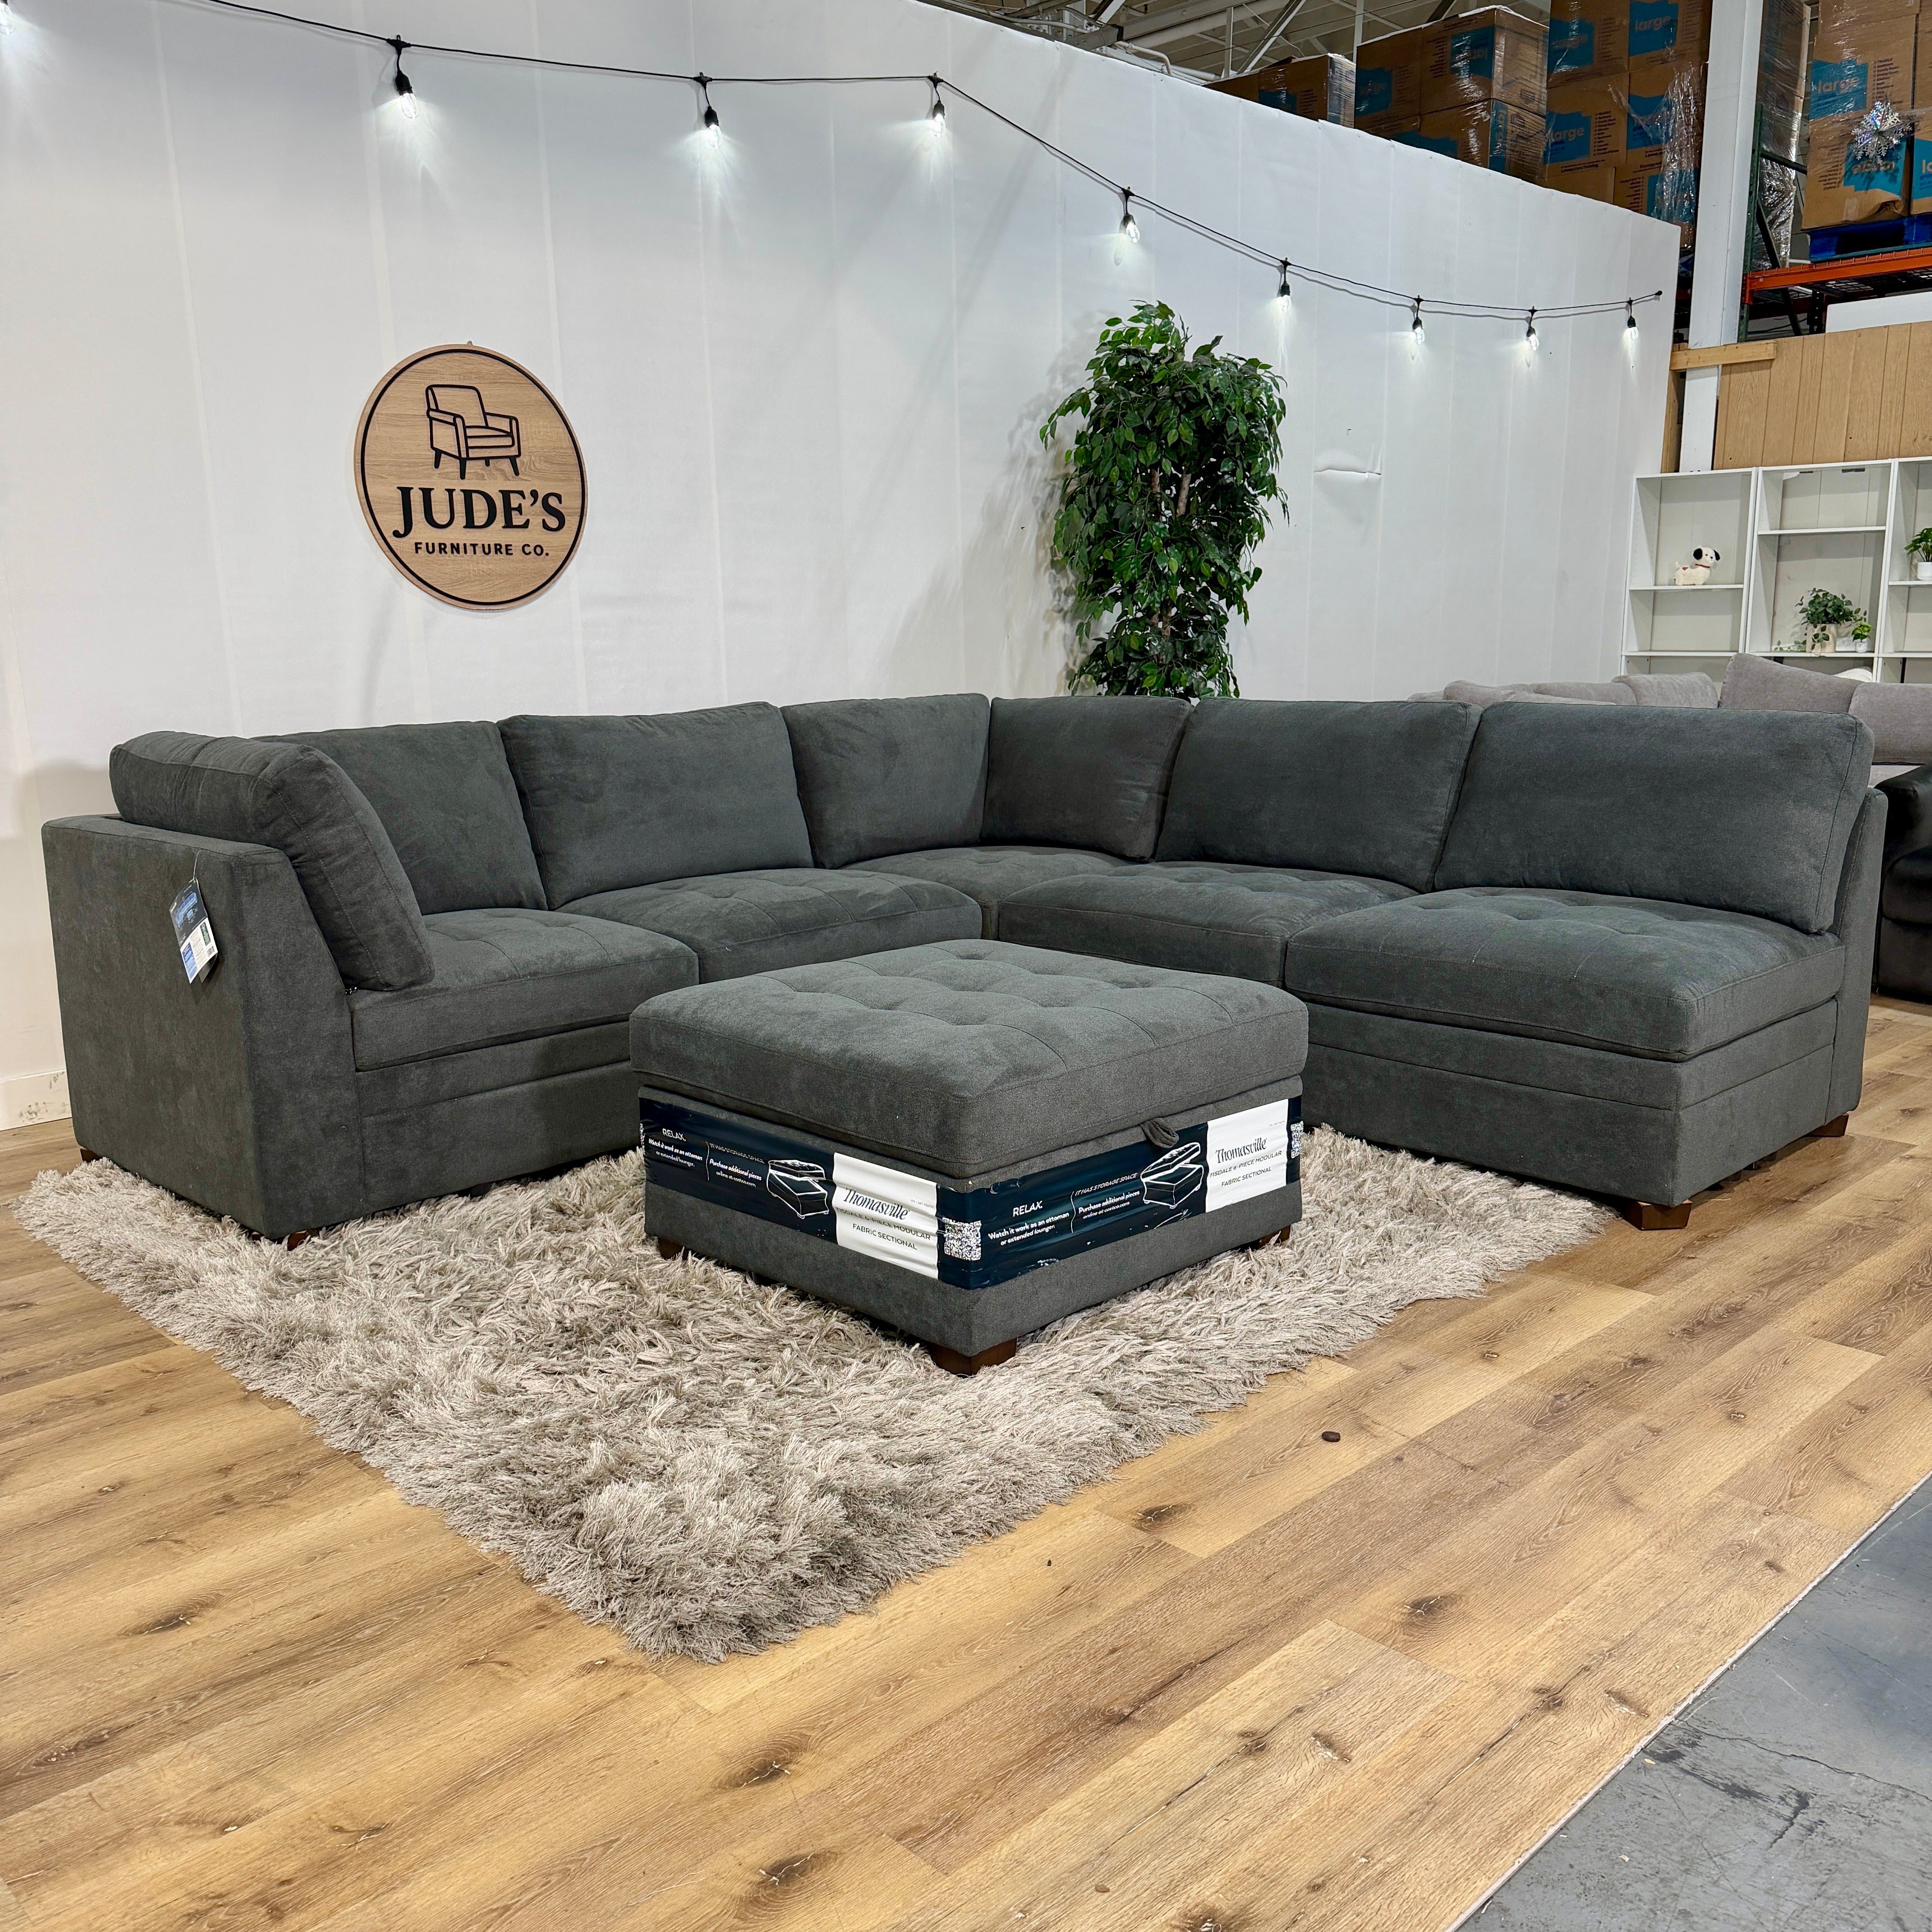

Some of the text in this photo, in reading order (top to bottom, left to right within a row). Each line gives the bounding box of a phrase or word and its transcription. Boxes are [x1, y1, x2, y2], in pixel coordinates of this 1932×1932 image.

[1635, 16, 1670, 32] large
[1818, 77, 1859, 94] large
[1550, 128, 1584, 142] large
[393, 486, 566, 538] JUDE'S
[414, 542, 550, 557] FURNITURE CO.
[662, 1128, 686, 1141] RELAX.
[649, 1138, 660, 1147] Watch
[685, 1151, 703, 1161] ottoman
[1215, 1137, 1267, 1164] Thomasville
[709, 1159, 762, 1181] Purchase additional pieces
[1210, 1150, 1282, 1178] TISDALE 6-PIECE MODULAR
[1081, 1186, 1093, 1194] HAS
[1093, 1178, 1120, 1191] STORAGE
[1221, 1167, 1271, 1187] FABRIC SECTIONAL
[843, 1187, 908, 1220] Thomasville
[1013, 1201, 1043, 1217] RELAX.
[1078, 1191, 1140, 1214] Purchase additional pieces
[837, 1207, 865, 1219] TISDALE
[893, 1224, 931, 1240] MODULAR
[988, 1229, 1009, 1240] Watch
[1015, 1223, 1030, 1232] work
[1045, 1212, 1069, 1224] ottoman
[852, 1224, 917, 1250] FABRIC SECTIONAL
[1007, 1230, 1034, 1243] extended
